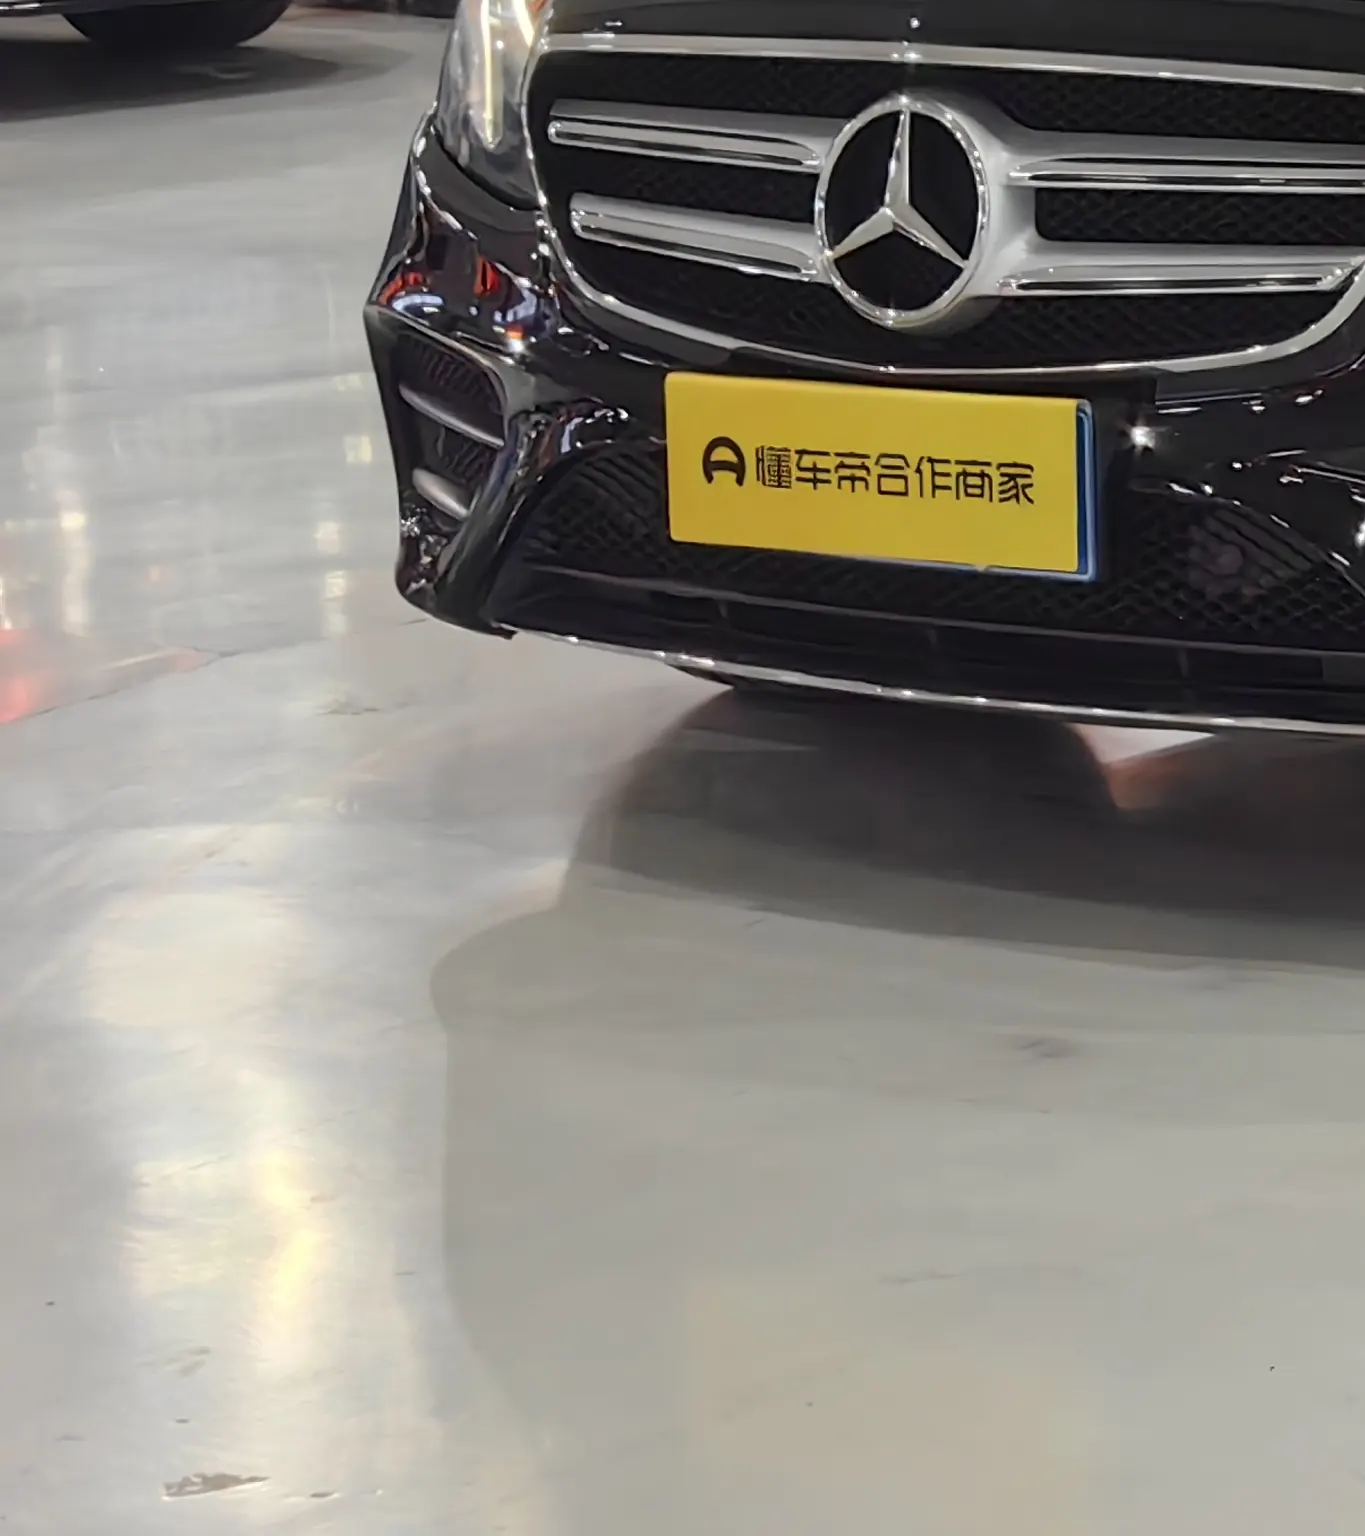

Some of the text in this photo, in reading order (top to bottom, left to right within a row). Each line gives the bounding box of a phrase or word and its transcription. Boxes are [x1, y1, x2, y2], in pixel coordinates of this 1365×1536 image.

[754, 444, 1035, 506] 懂车帝合作商家
